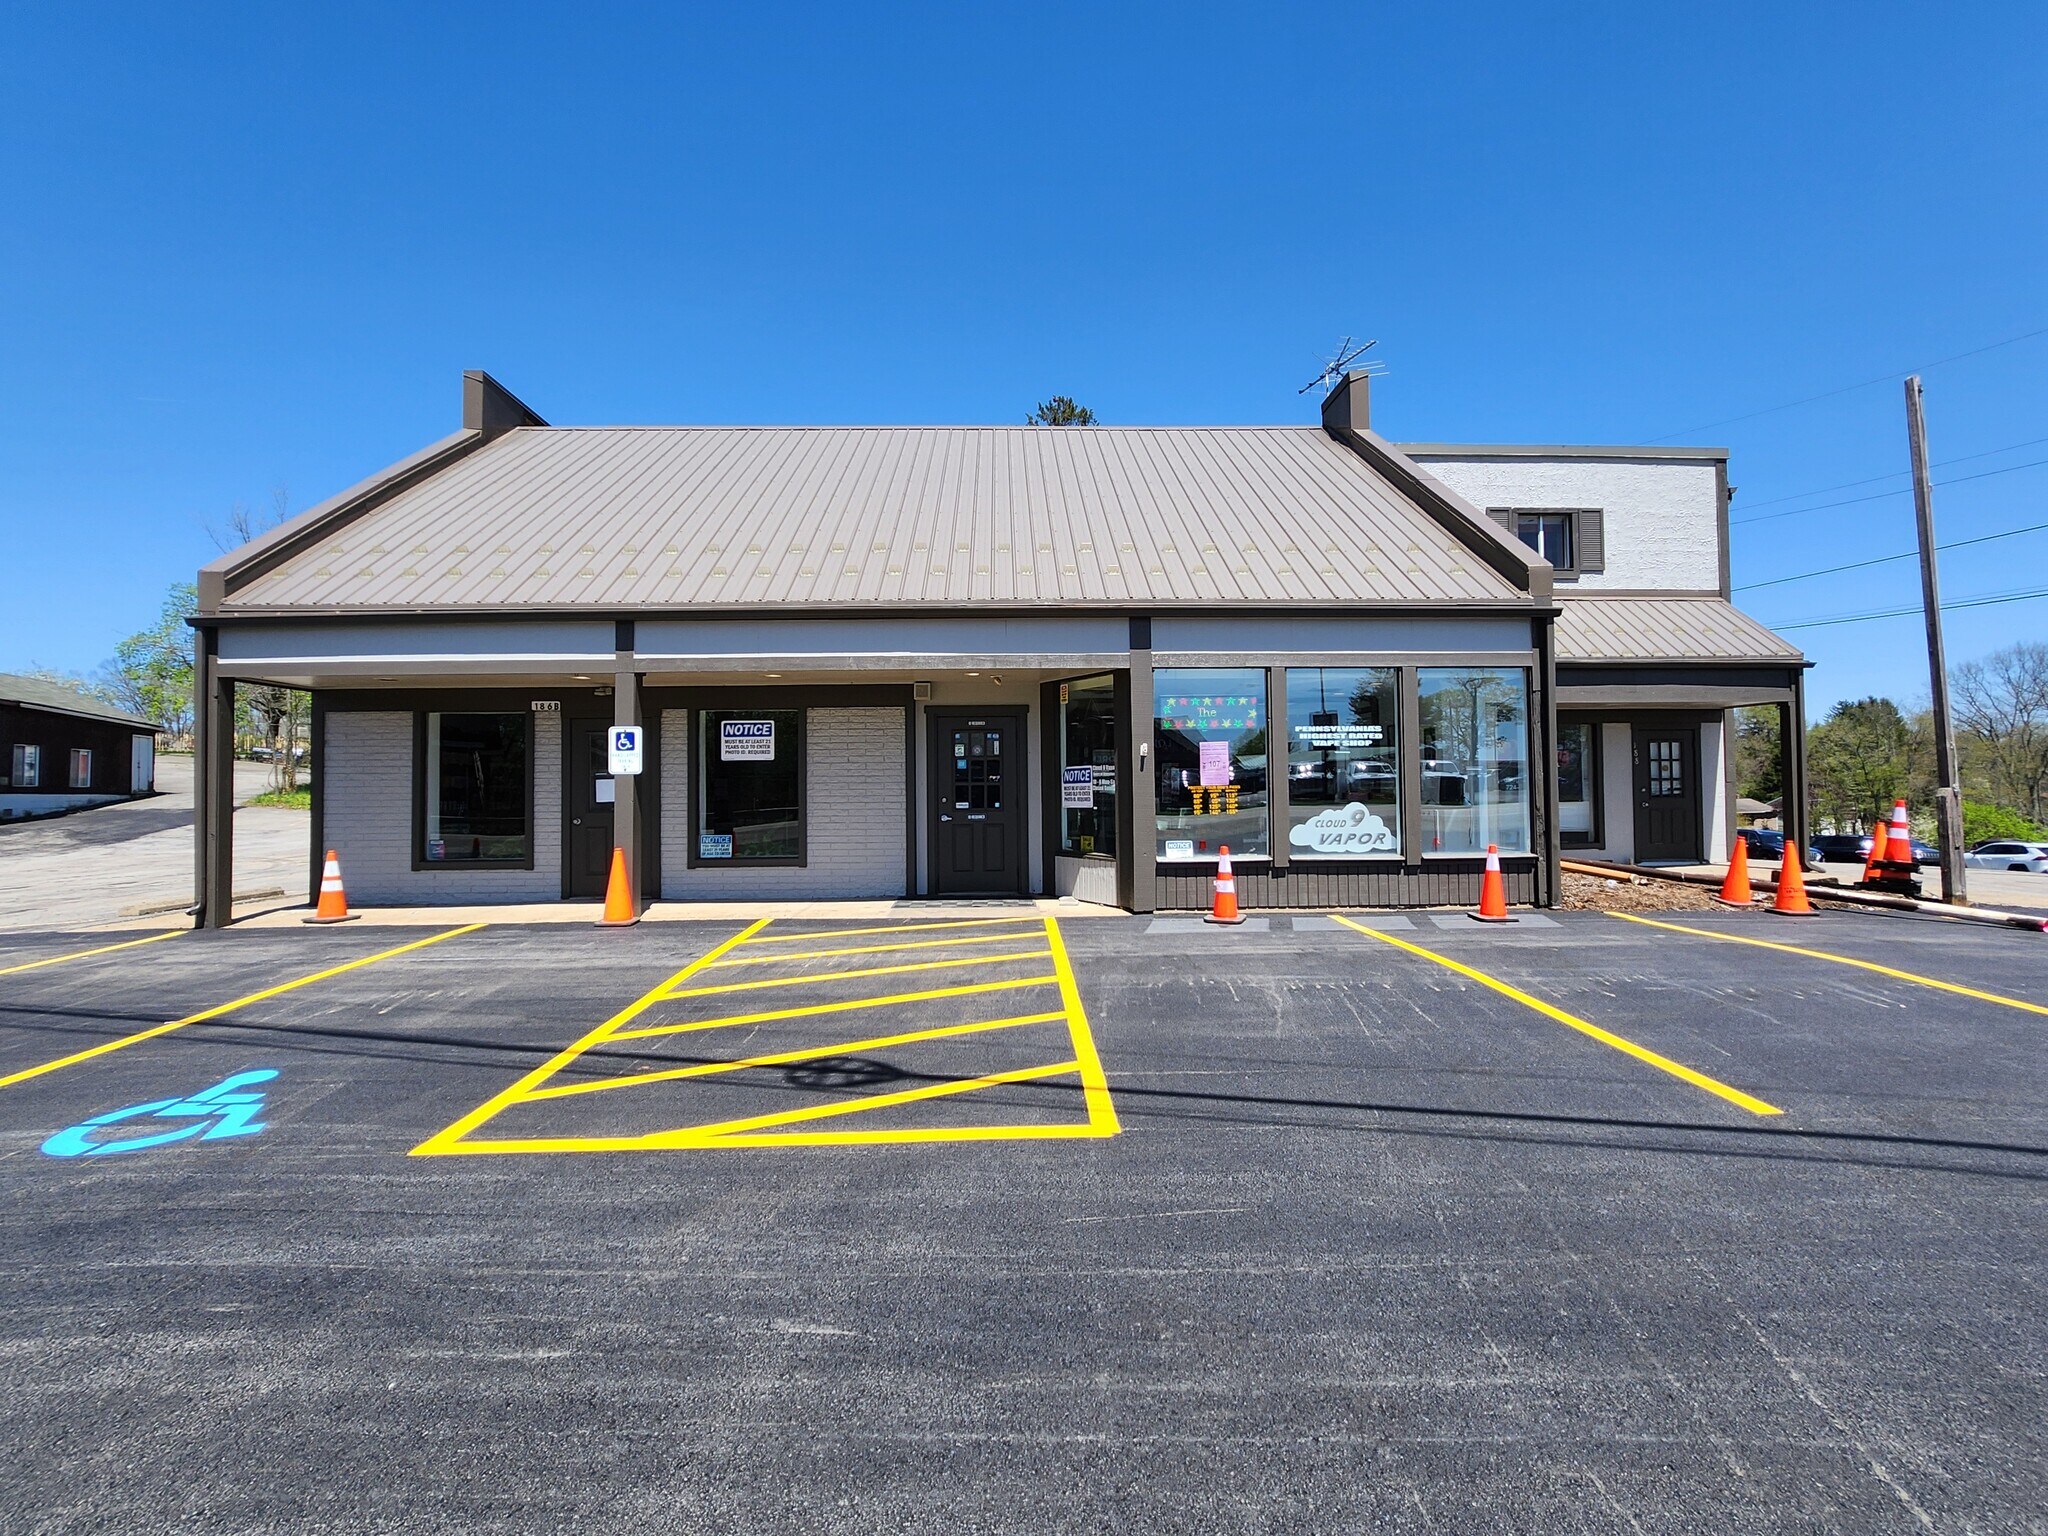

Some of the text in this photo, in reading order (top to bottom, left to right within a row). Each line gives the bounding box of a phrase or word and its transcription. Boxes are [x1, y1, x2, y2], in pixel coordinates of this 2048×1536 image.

[1197, 707, 1217, 717] The
[725, 724, 771, 735] NOTICE
[1208, 760, 1221, 768] 107
[1064, 769, 1090, 782] NOTICE
[1315, 809, 1365, 828] CLOUD 9
[1319, 833, 1387, 845] VAPOR
